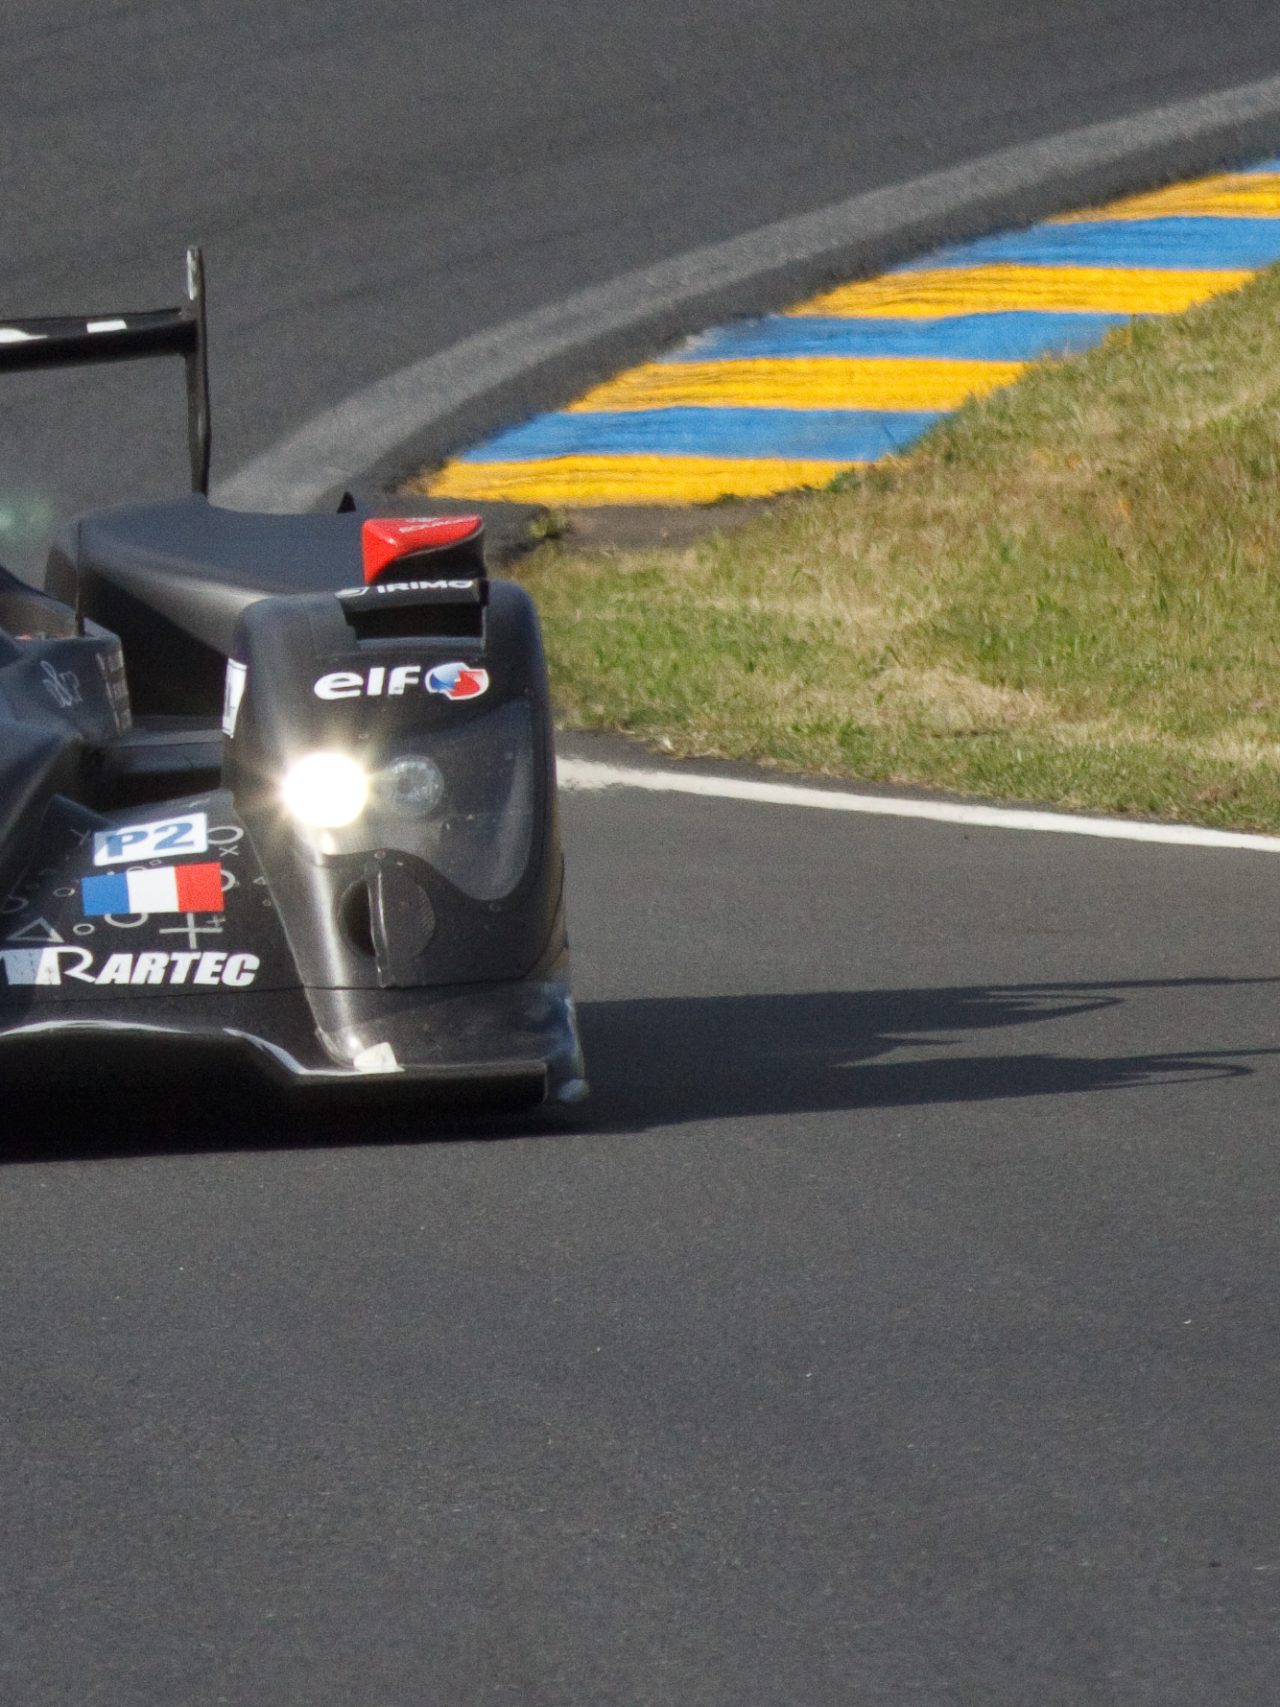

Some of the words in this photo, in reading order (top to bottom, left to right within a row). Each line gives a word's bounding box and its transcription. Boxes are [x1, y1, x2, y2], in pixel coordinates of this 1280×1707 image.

[377, 580, 473, 593] IRIMO
[314, 666, 421, 700] elf
[105, 821, 195, 857] P2
